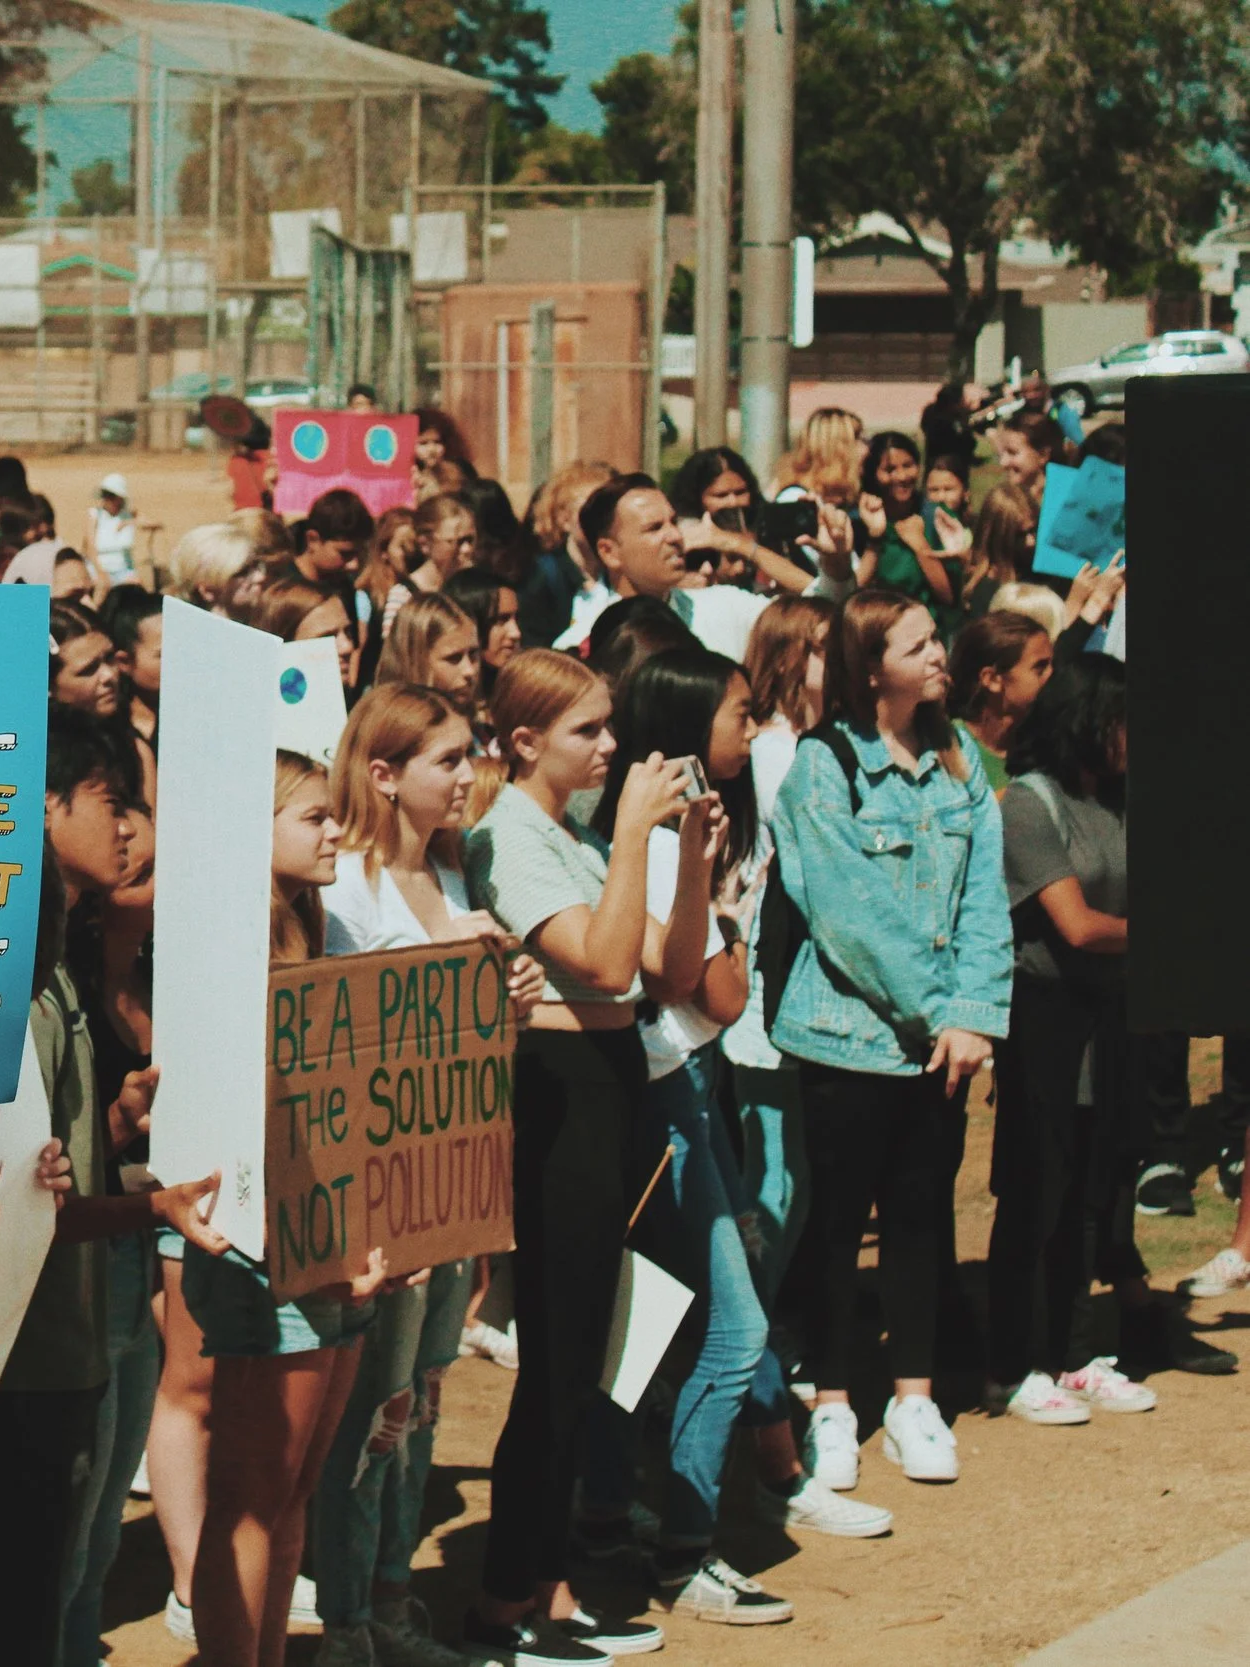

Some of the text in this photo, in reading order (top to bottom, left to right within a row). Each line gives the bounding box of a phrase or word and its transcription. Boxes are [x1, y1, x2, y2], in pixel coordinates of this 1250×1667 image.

[272, 982, 318, 1076] BE
[326, 976, 355, 1070] A
[379, 955, 468, 1063] PART
[365, 1055, 515, 1147] SOLUTION
[277, 1174, 354, 1284] NOT
[365, 1128, 515, 1249] POLLUTION
